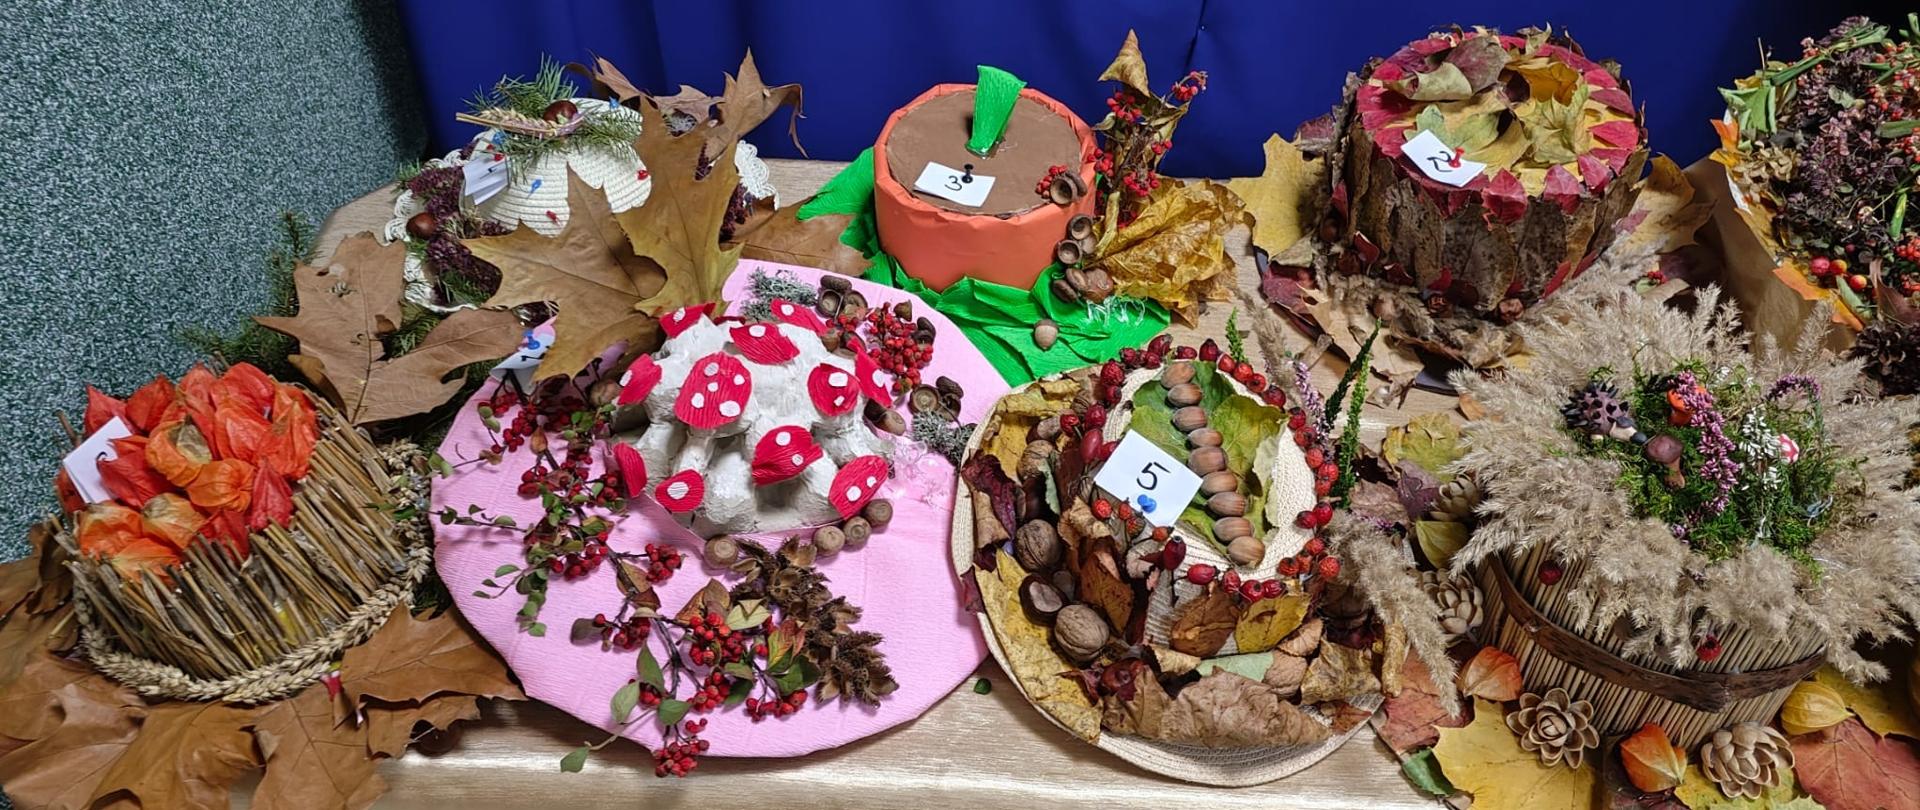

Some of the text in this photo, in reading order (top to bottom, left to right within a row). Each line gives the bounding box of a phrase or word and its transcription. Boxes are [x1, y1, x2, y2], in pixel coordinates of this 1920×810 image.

[1426, 150, 1453, 173] 2
[944, 175, 963, 191] 3
[1136, 461, 1171, 490] 5
